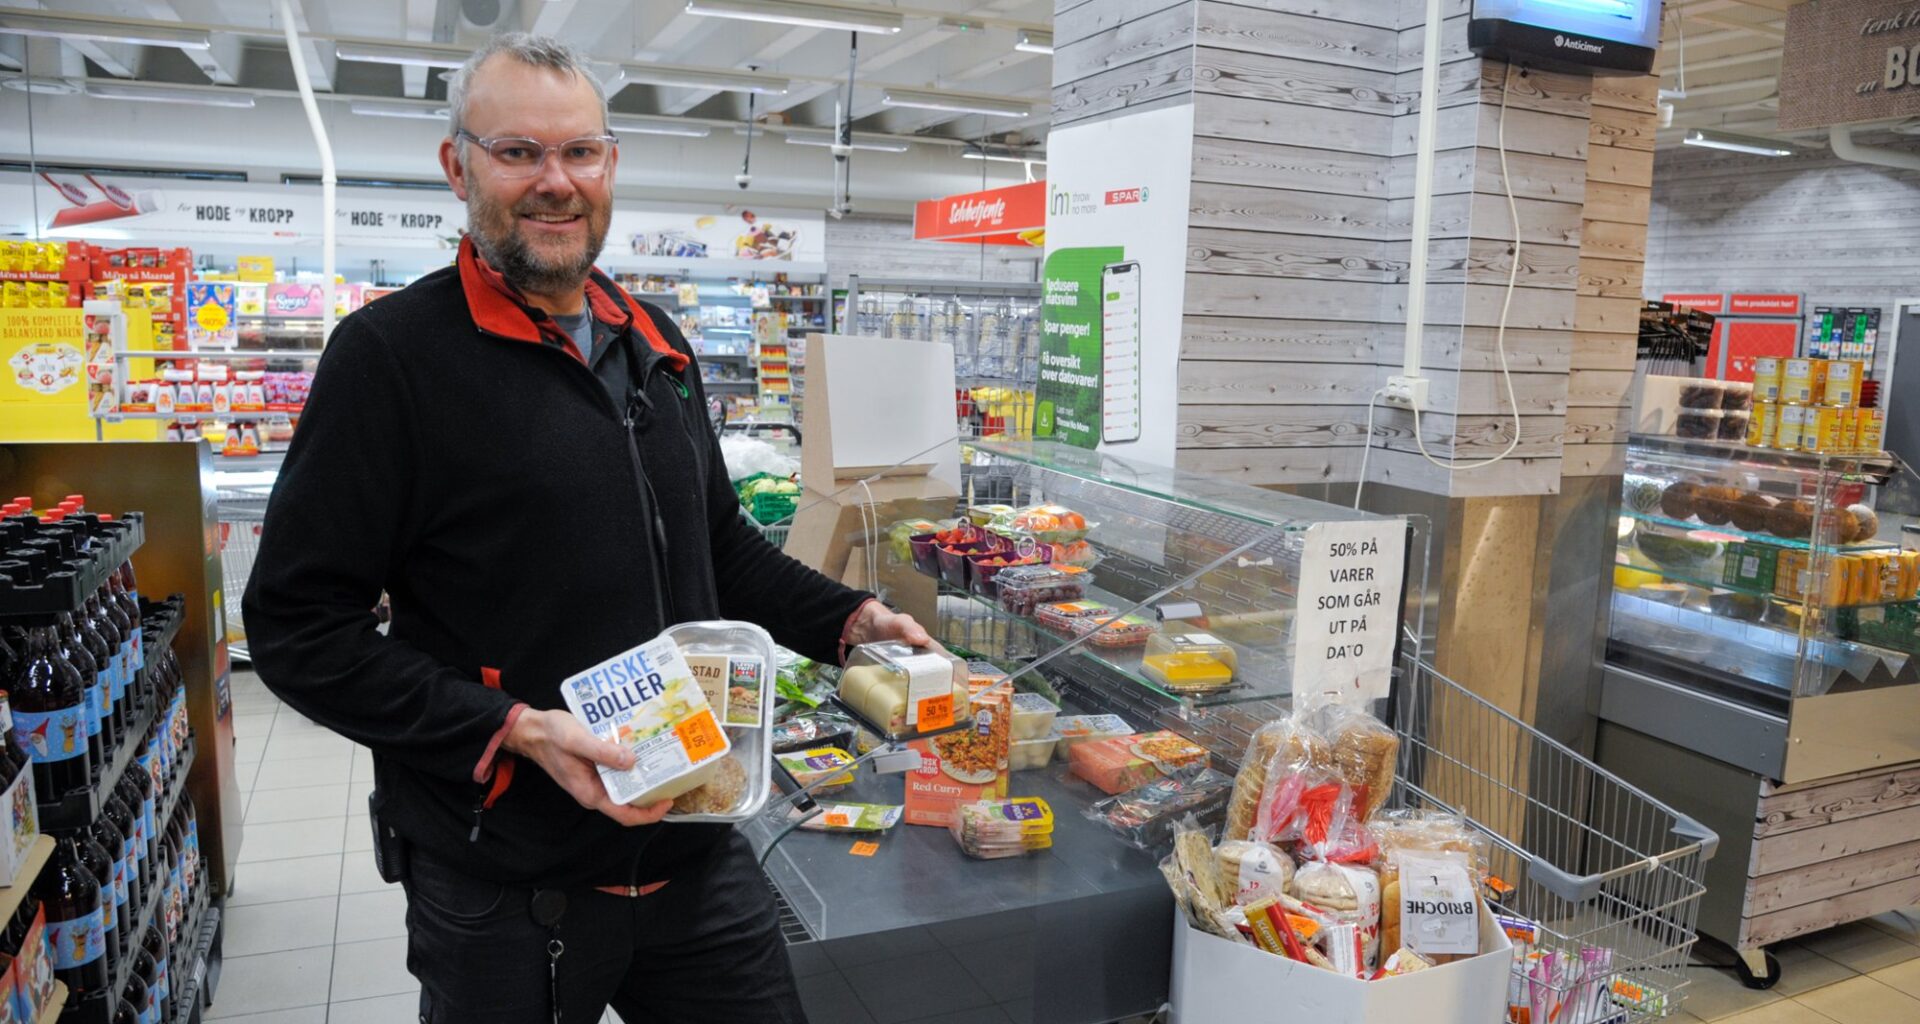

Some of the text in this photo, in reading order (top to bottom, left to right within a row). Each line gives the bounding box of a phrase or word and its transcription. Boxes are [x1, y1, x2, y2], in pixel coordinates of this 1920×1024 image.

[1564, 37, 1602, 54] Anticimex
[1112, 190, 1139, 203] SPAR
[196, 205, 231, 222] HODE
[249, 207, 294, 224] KROPP
[351, 211, 384, 226] HODE
[400, 213, 442, 229] KROPP
[1046, 278, 1079, 292] Redusere
[1045, 292, 1077, 306] matsvinn
[1044, 319, 1090, 338] Spar penger!
[1050, 354, 1081, 369] oversikt
[1041, 369, 1098, 388] over datovarer!
[1329, 537, 1379, 557] 50% PÅ
[1330, 567, 1375, 583] VARER
[1317, 588, 1381, 610] SOM GÅR
[1329, 614, 1368, 635] UT PÅ
[591, 650, 654, 695] FISKE
[689, 664, 721, 679] STAD
[581, 672, 667, 725] BOLLER
[926, 705, 936, 716] 50
[912, 781, 932, 792] Red
[933, 783, 963, 797] Curry
[1406, 901, 1473, 915] BRIOCHE
